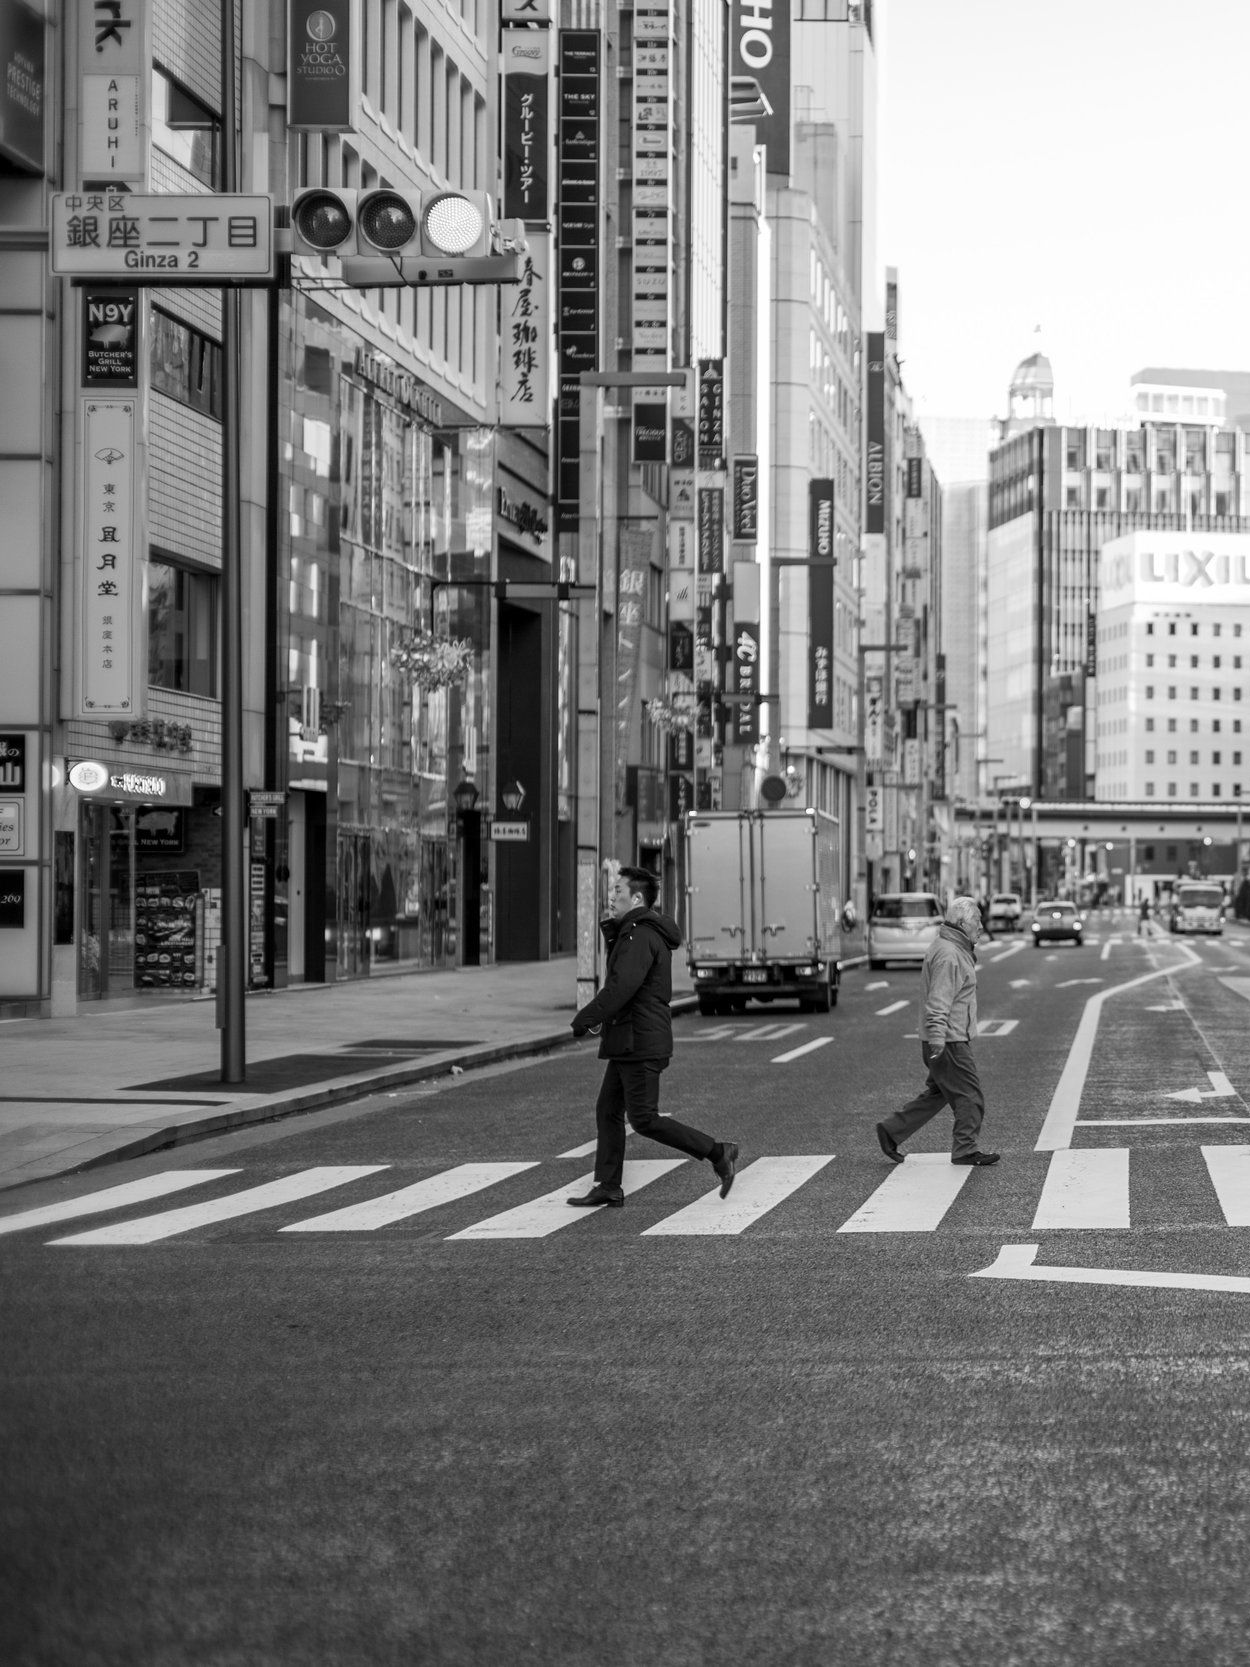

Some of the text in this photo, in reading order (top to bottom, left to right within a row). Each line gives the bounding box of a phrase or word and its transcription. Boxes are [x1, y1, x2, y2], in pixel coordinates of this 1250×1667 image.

[305, 42, 337, 53] HOT
[299, 53, 343, 65] YOGA
[297, 66, 334, 75] STUDIO
[107, 79, 119, 168] ARUHI
[65, 194, 125, 212] 中央区
[66, 214, 257, 248] 銀座二丁目
[124, 250, 199, 269] Ginza 2
[88, 303, 133, 322] N9Y
[89, 365, 132, 373] NEW YORK
[868, 440, 883, 505] ALBION
[817, 499, 832, 556] MIZUHO
[102, 615, 113, 669] 銀座本店
[739, 665, 753, 735] BRDAL
